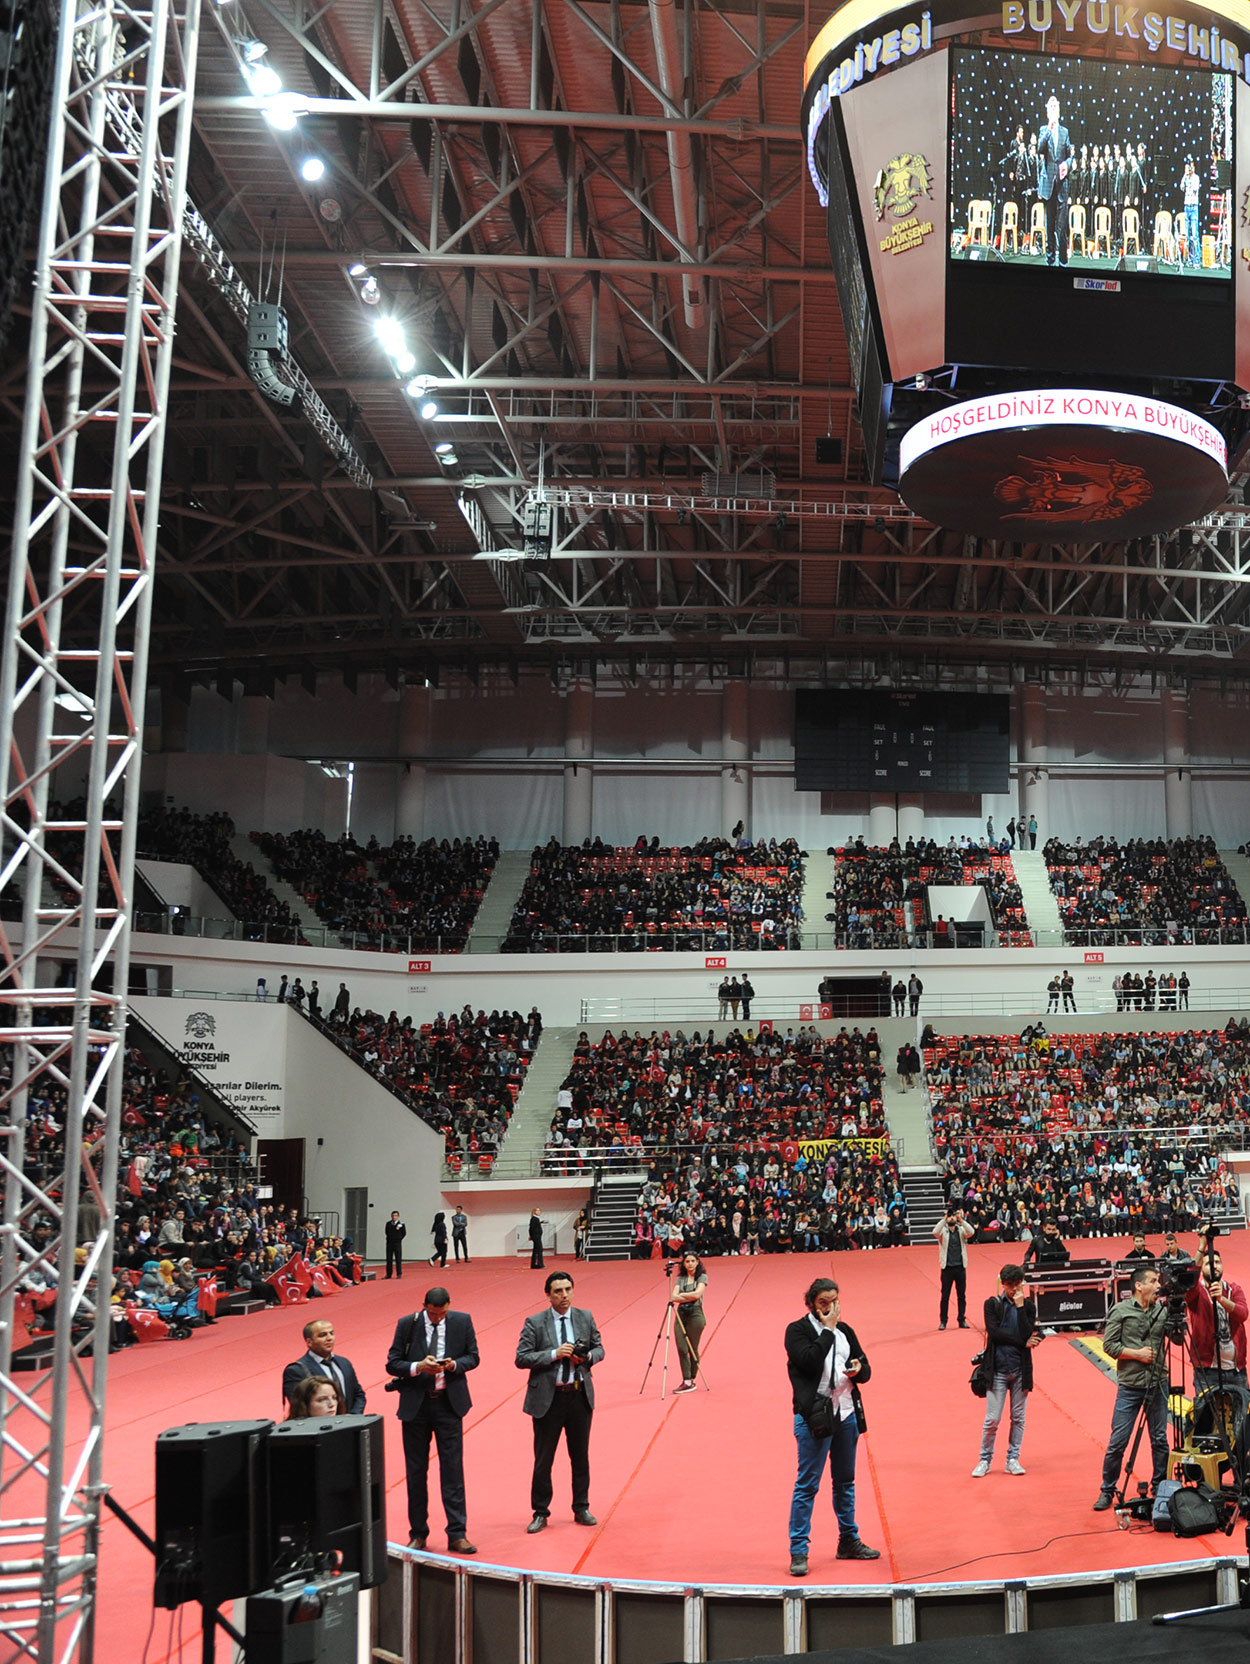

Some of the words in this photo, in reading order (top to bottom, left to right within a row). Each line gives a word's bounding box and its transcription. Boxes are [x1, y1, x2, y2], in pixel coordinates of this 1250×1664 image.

[930, 394, 1055, 438] HOŞGELDİNİZ
[1063, 398, 1138, 420] KONYA
[1144, 405, 1224, 459] BÜYÜKŞEHİR
[183, 1042, 215, 1050] KONYA
[174, 1050, 230, 1063] ÜYÜKŞEHİR
[245, 1082, 282, 1090] Dilerim.
[234, 1094, 267, 1102] players.
[249, 1105, 281, 1113] Akyürek
